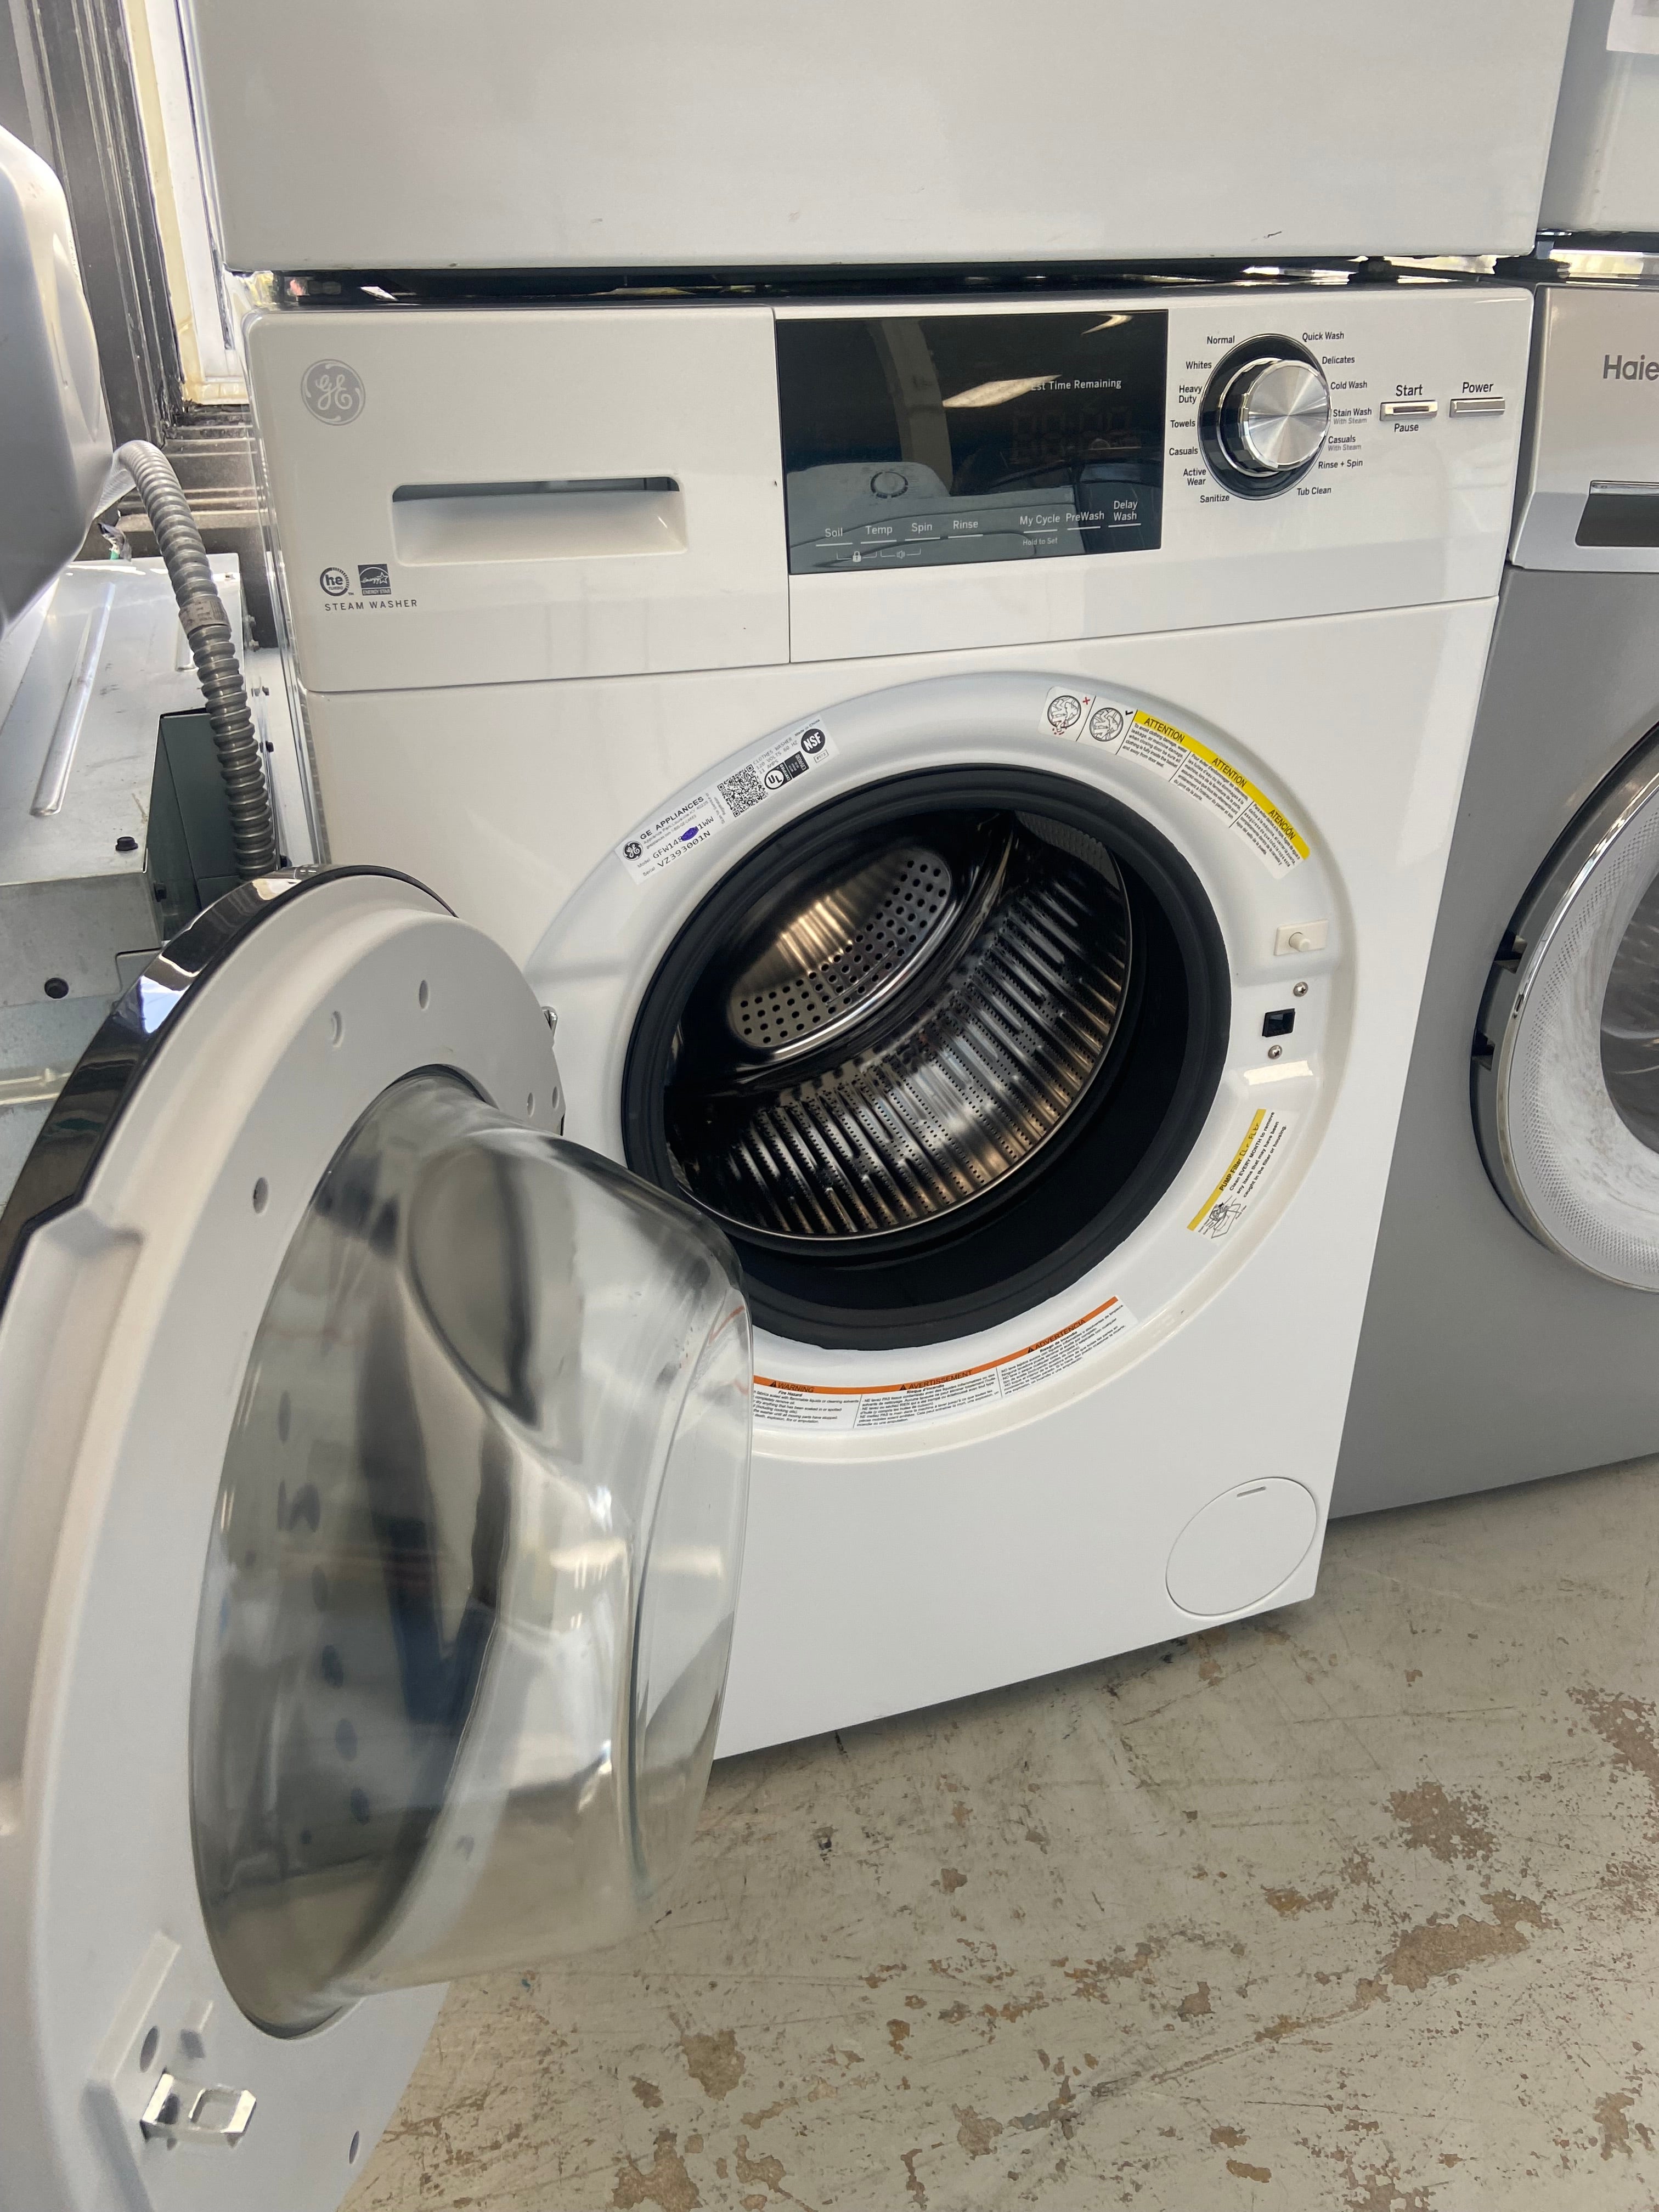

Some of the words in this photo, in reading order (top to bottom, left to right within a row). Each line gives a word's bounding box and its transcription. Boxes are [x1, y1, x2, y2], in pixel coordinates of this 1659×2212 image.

[1207, 335, 1235, 344] Normal
[1302, 332, 1323, 342] Quick
[1325, 331, 1344, 340] Wash
[1186, 361, 1212, 369] Whites
[1322, 356, 1355, 364] Delicates
[1049, 381, 1071, 390] Time
[1074, 379, 1122, 389] Remaining
[1179, 385, 1203, 394] Heavy
[1330, 381, 1347, 390] Cold
[1348, 380, 1368, 389] Wash
[1396, 384, 1423, 396] Start
[1462, 382, 1494, 393] Power
[1179, 395, 1197, 404] Duty
[1333, 409, 1351, 417] Stain
[1353, 408, 1372, 416] Wash
[1170, 419, 1195, 428] Towels
[1394, 423, 1419, 432] Pause
[1328, 435, 1356, 444] Casuals
[1169, 447, 1198, 455] Casuals
[1347, 459, 1363, 469] Spin
[1183, 468, 1206, 477] Active
[1187, 478, 1206, 486] Wear
[1312, 487, 1331, 495] Clean
[1200, 494, 1229, 503] Sanitize
[1114, 500, 1138, 510] Delay
[1020, 516, 1034, 527] My
[1036, 514, 1060, 526] Cycle
[1066, 511, 1104, 522] PreWash
[1113, 511, 1137, 521] Wash
[865, 525, 893, 536] Temp
[911, 522, 933, 534] Spin
[953, 520, 979, 530] Rinse
[825, 527, 843, 538] Soil
[325, 574, 343, 586] he
[325, 602, 364, 611] STEAM
[369, 600, 417, 609] WASHER
[1144, 718, 1185, 743] ATTENTION
[803, 732, 821, 751] NSF
[753, 749, 774, 765] CLOTHES
[774, 737, 793, 751] WASHER
[756, 761, 765, 770] 120
[766, 751, 782, 763] VOLTS
[1211, 758, 1247, 788] ATTENTION
[768, 775, 782, 784] UL
[640, 830, 652, 839] GE
[656, 797, 704, 831] APPLIANCES
[1268, 809, 1296, 840] ATENCIÓN
[637, 857, 651, 868] Model
[653, 816, 714, 859] GFW1481WW
[642, 866, 656, 877] Serial
[657, 830, 710, 867] VZ393001N
[1229, 1177, 1241, 1191] Clean
[1238, 1158, 1251, 1176] EVERY
[1249, 1138, 1262, 1158] MONTH
[1263, 1112, 1275, 1131] remove
[1242, 1171, 1253, 1184] items
[1251, 1160, 1260, 1170] that
[1258, 1148, 1266, 1159] may
[1263, 1135, 1273, 1148] have
[1270, 1121, 1279, 1135] been
[1243, 1181, 1256, 1198] caught
[1262, 1154, 1271, 1166] filter
[1272, 1126, 1286, 1147] housing.
[1218, 1173, 1232, 1191] PUMP
[1230, 1158, 1242, 1173] Filter
[1035, 1318, 1086, 1349] ADVERTENCIA
[909, 1370, 973, 1389] AVERTISSEMENT
[777, 1383, 815, 1393] WARNING
